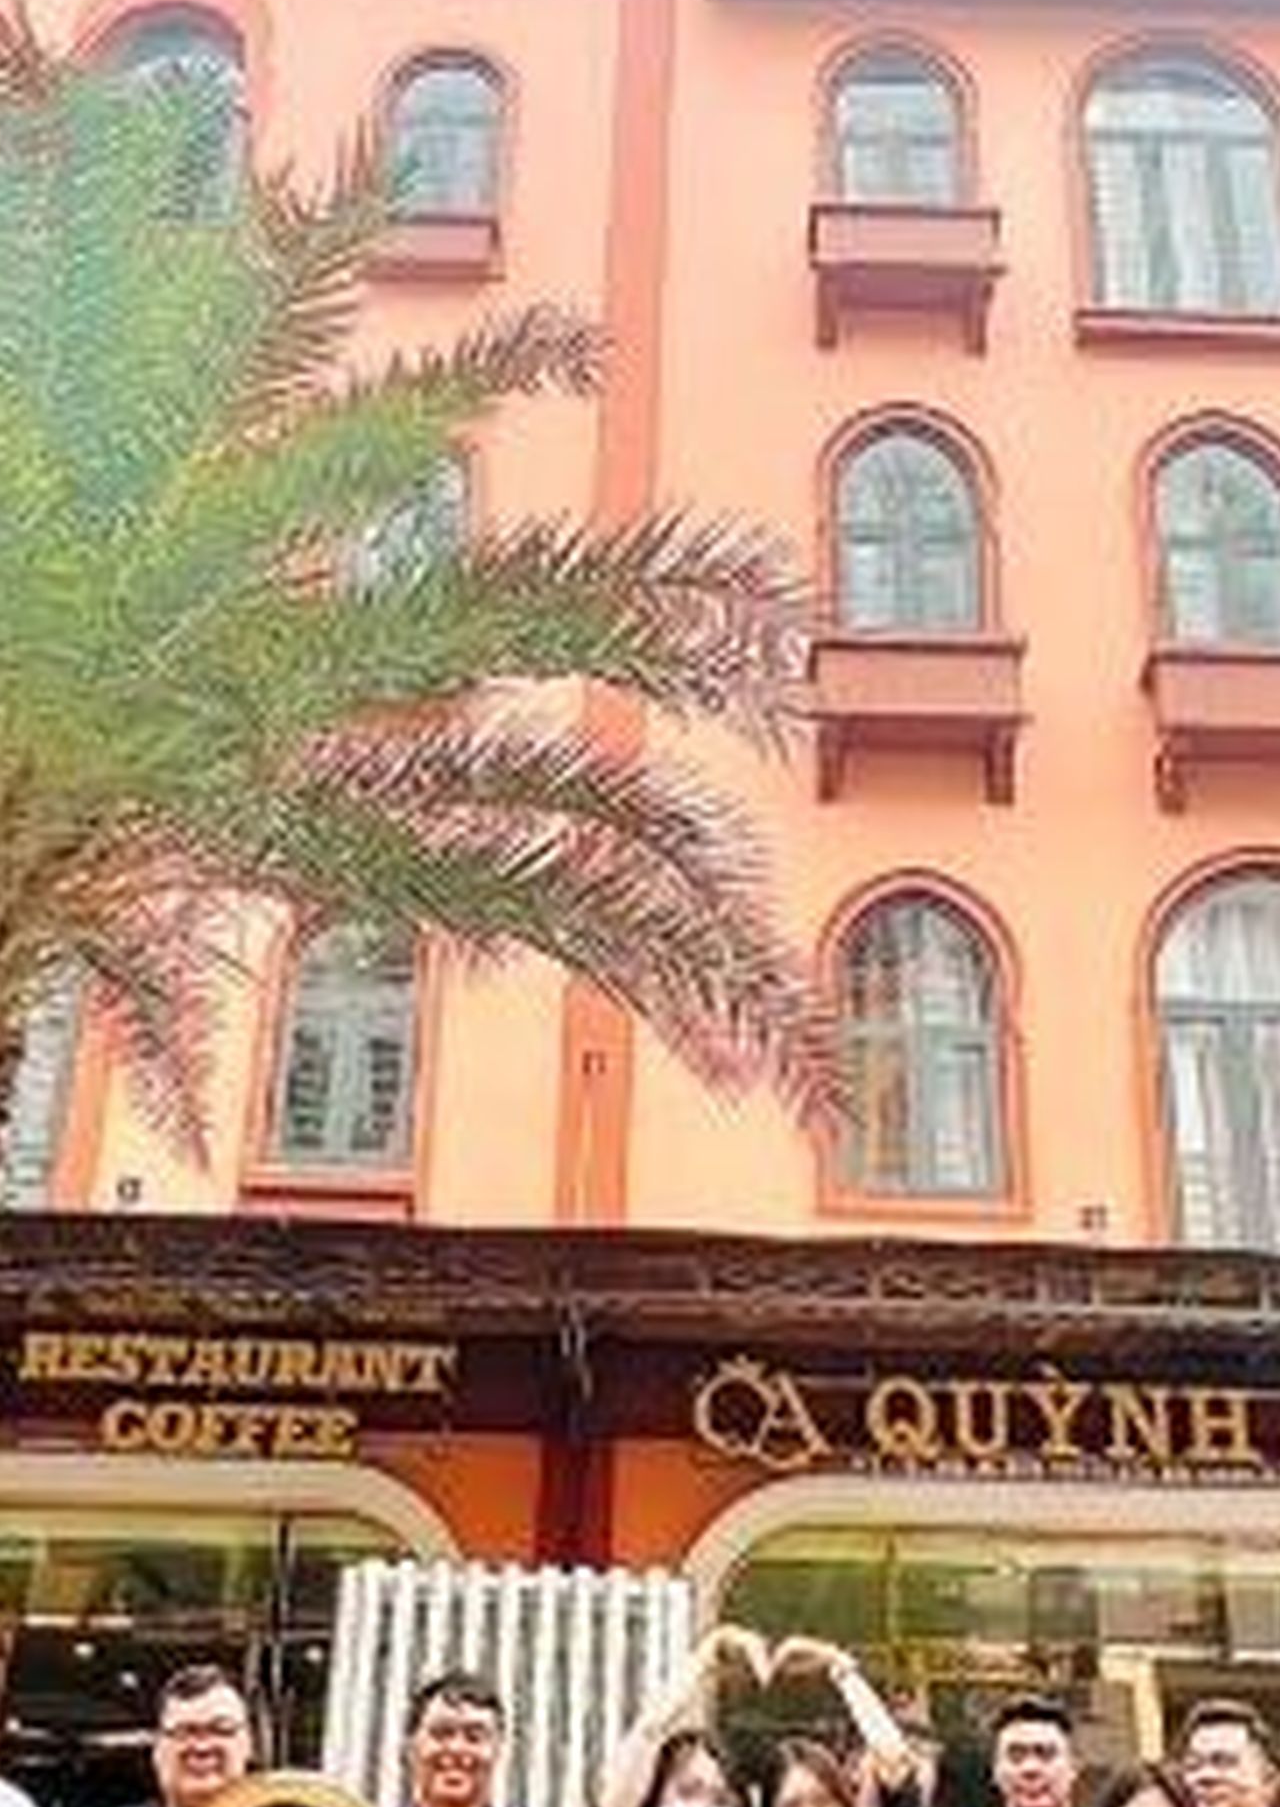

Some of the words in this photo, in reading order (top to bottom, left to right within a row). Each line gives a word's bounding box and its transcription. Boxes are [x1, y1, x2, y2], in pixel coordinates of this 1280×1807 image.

[20, 1331, 457, 1393] RESTAURANT
[99, 1403, 358, 1457] COFFEE
[866, 1361, 1261, 1465] QUỲNH
